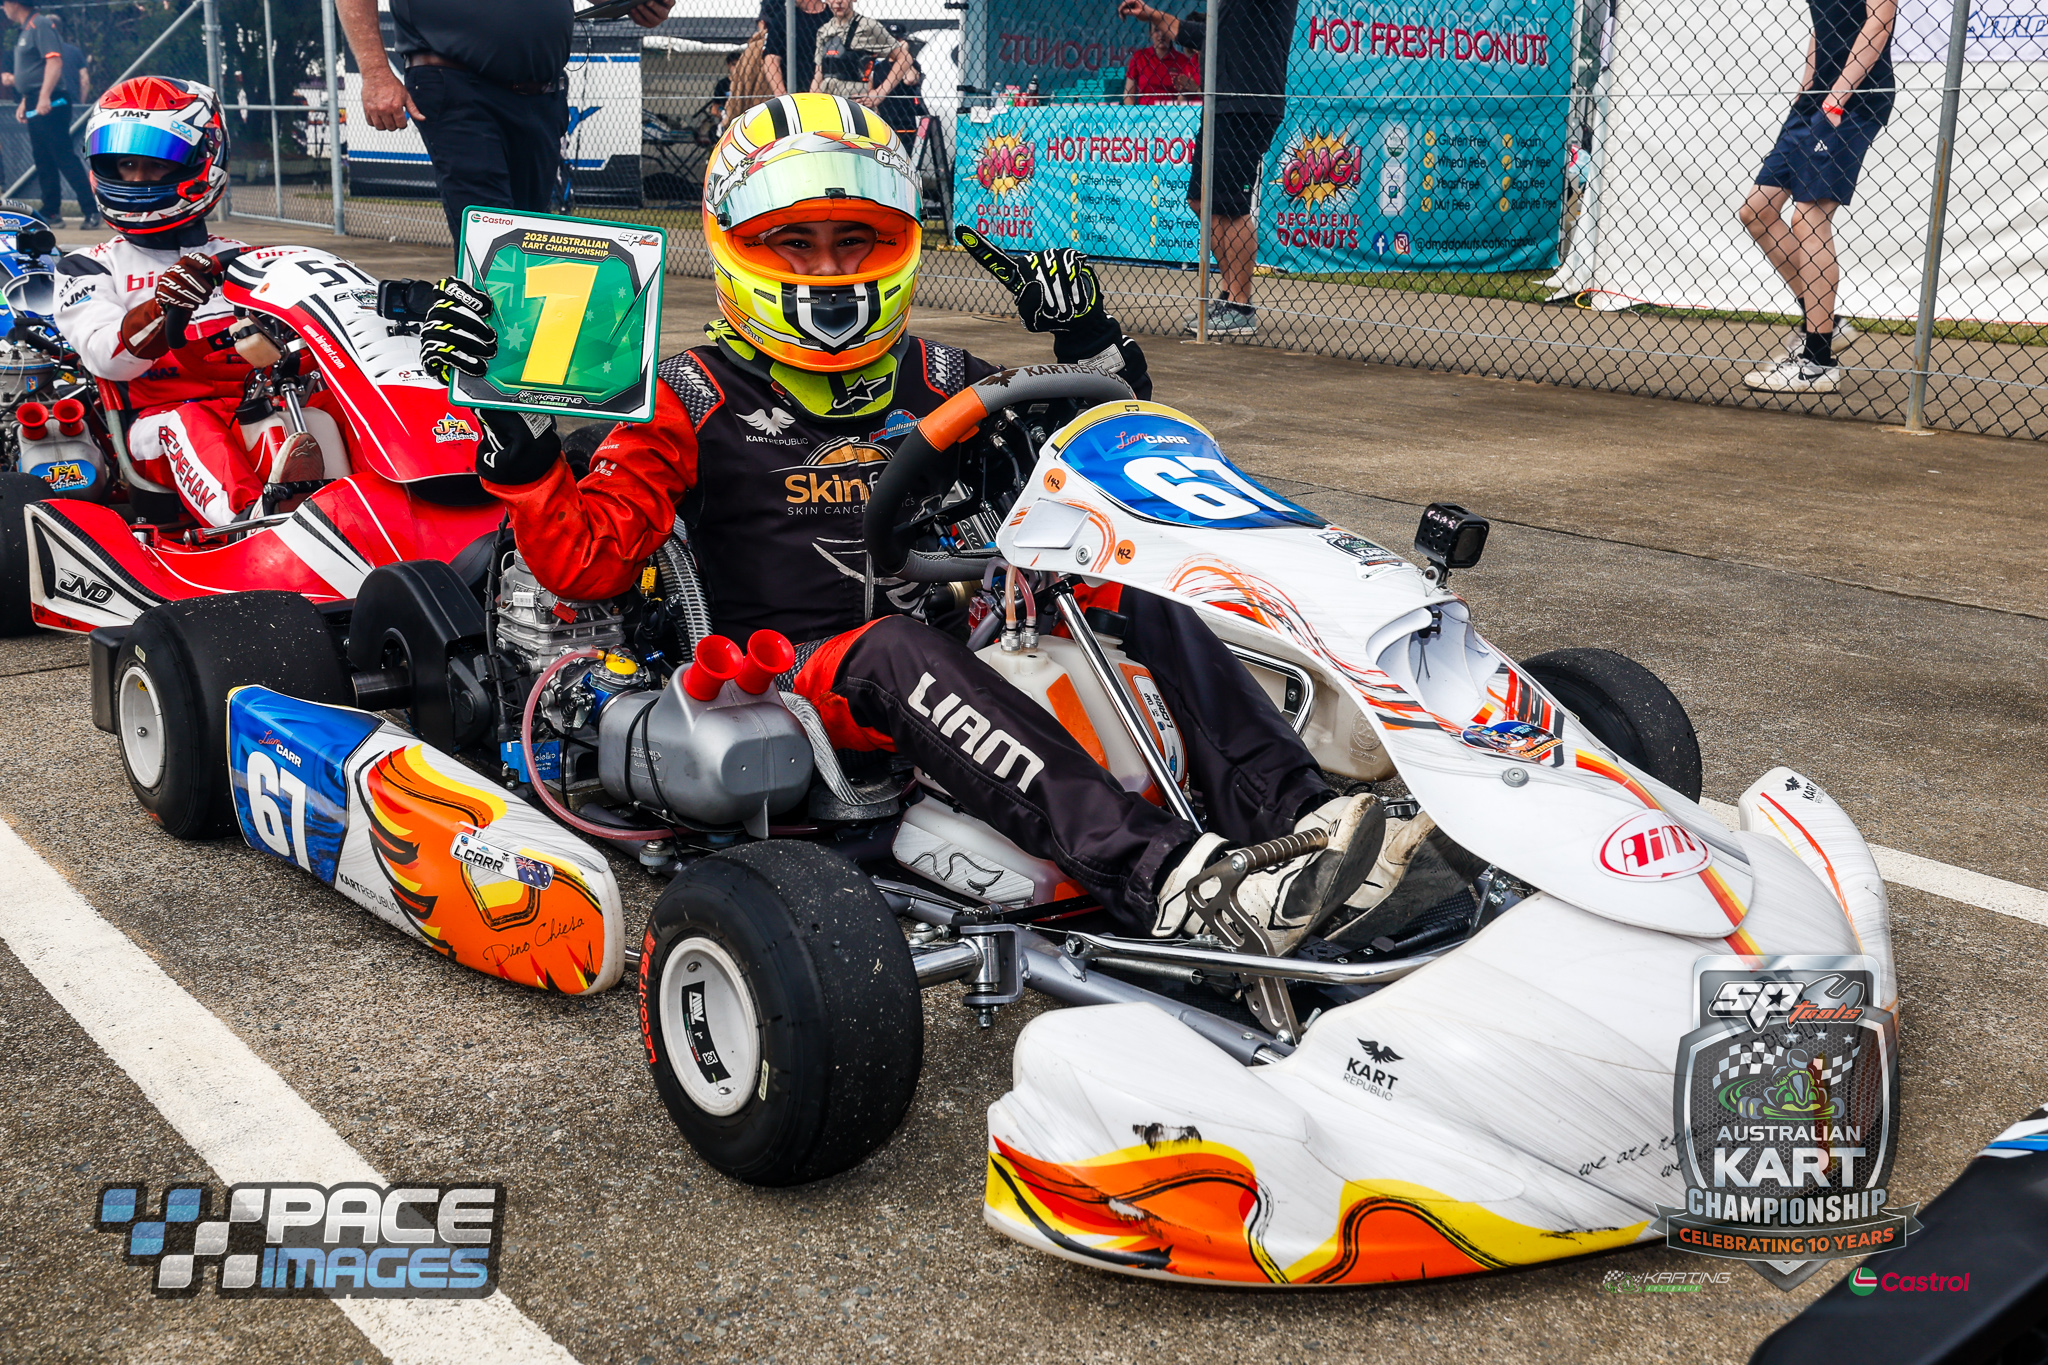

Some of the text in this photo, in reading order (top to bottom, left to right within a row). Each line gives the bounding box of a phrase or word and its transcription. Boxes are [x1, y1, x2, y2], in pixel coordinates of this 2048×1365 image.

[1309, 16, 1548, 67] HOT FRESH DONUTS
[170, 120, 193, 137] DGA
[1437, 135, 1487, 148] Gluten Free
[1047, 137, 1085, 162] HOT
[1090, 137, 1148, 163] FRESH
[1514, 136, 1542, 148] Vegan
[977, 141, 1035, 188] OMG!
[1282, 146, 1362, 196] OMG!
[1437, 156, 1487, 169] Wheat Free
[1461, 178, 1480, 190] Free
[1450, 200, 1470, 211] Free
[482, 215, 513, 226] Castrol
[1177, 218, 1200, 229] Free
[1277, 211, 1359, 227] DECADENT
[522, 241, 608, 257] KART CHAMPIONSHIP
[524, 233, 610, 249] 2025 AUSTRALIAN
[1276, 228, 1359, 250] DONUTS
[445, 284, 484, 311] freem
[521, 262, 599, 385] 1
[302, 324, 346, 370] www.birelart.com
[935, 346, 947, 385] MIR
[678, 366, 715, 397] MIR
[539, 395, 582, 405] KARTING
[746, 435, 808, 446] KARTREPUBLIC
[1115, 431, 1190, 449] Liam CARR
[1124, 457, 1300, 520] 67
[787, 506, 819, 516] SKIN
[60, 569, 113, 604] JND
[908, 672, 1045, 793] LIAM
[258, 730, 302, 768] Liam CARR
[246, 750, 312, 874] 67
[483, 941, 530, 968] Dino
[1346, 1057, 1399, 1091] KART
[1343, 1073, 1394, 1102] REPUBLIC
